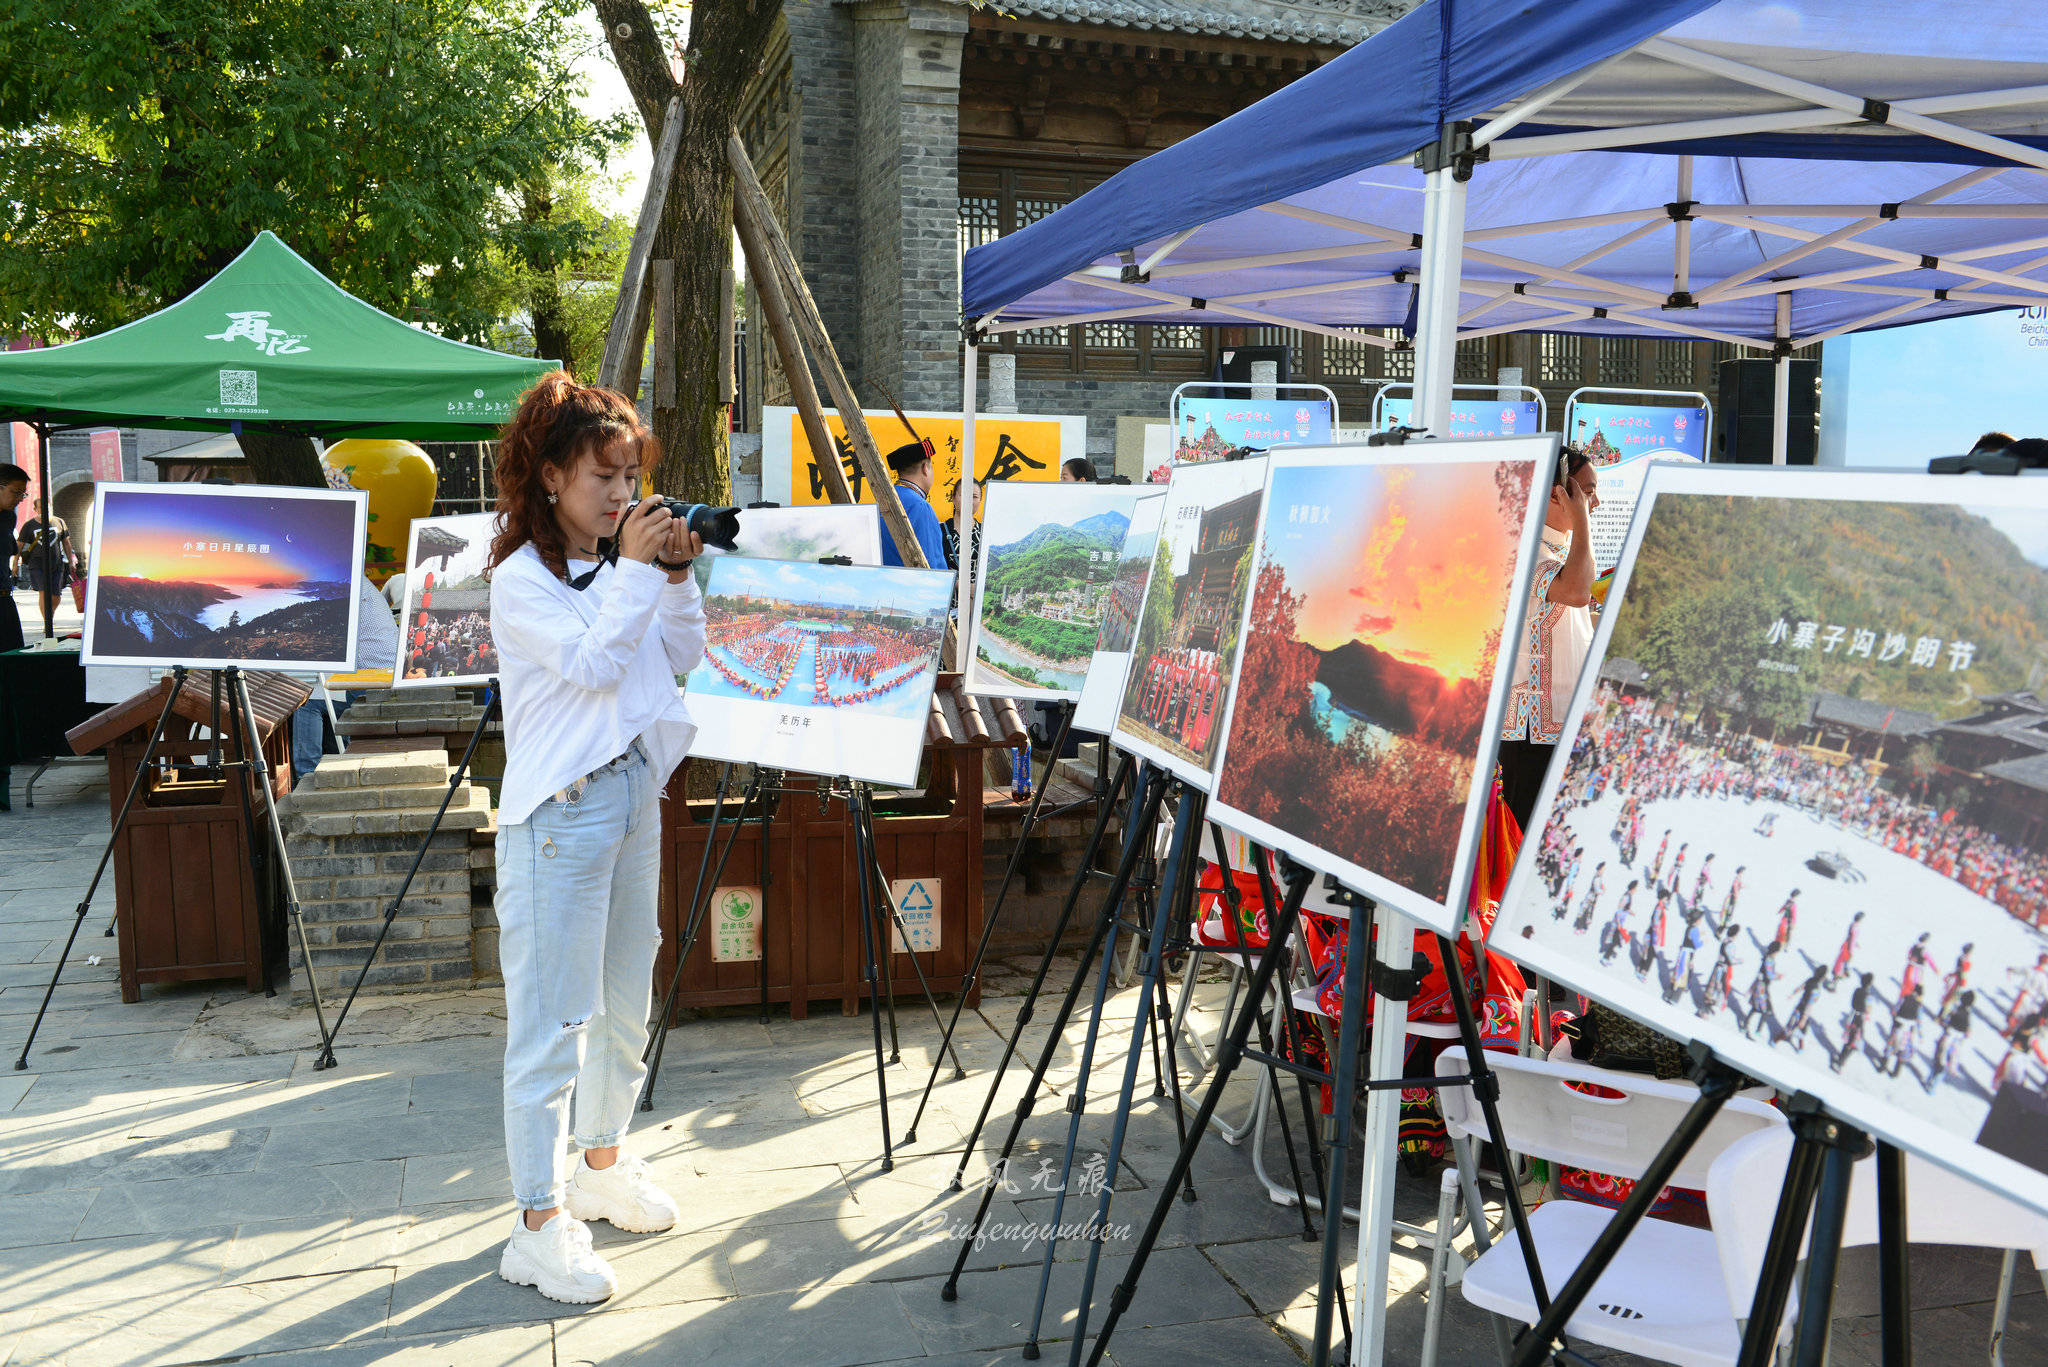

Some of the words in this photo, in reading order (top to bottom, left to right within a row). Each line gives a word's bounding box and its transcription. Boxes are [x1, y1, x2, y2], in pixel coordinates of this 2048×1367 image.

[204, 311, 312, 356] 再忆
[183, 541, 270, 554] 小寨日月星辰图
[1766, 617, 1977, 673] 小寨子沟沙朗节
